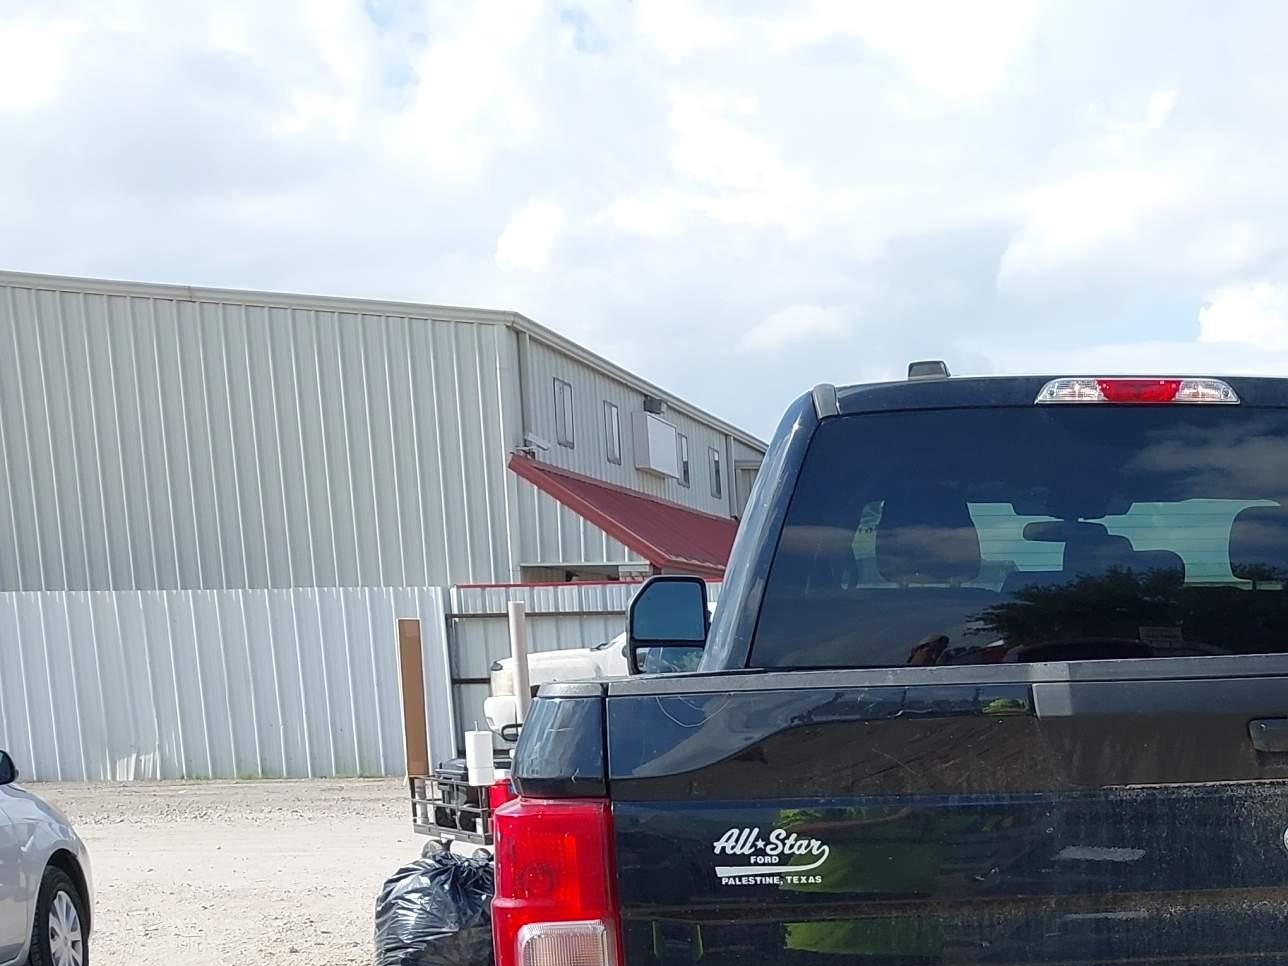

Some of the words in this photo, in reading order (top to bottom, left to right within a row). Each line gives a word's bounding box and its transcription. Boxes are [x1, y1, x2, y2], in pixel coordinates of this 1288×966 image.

[750, 856, 780, 864] FORD
[722, 876, 784, 885] PALESTINE,
[785, 875, 823, 884] TEXAS
